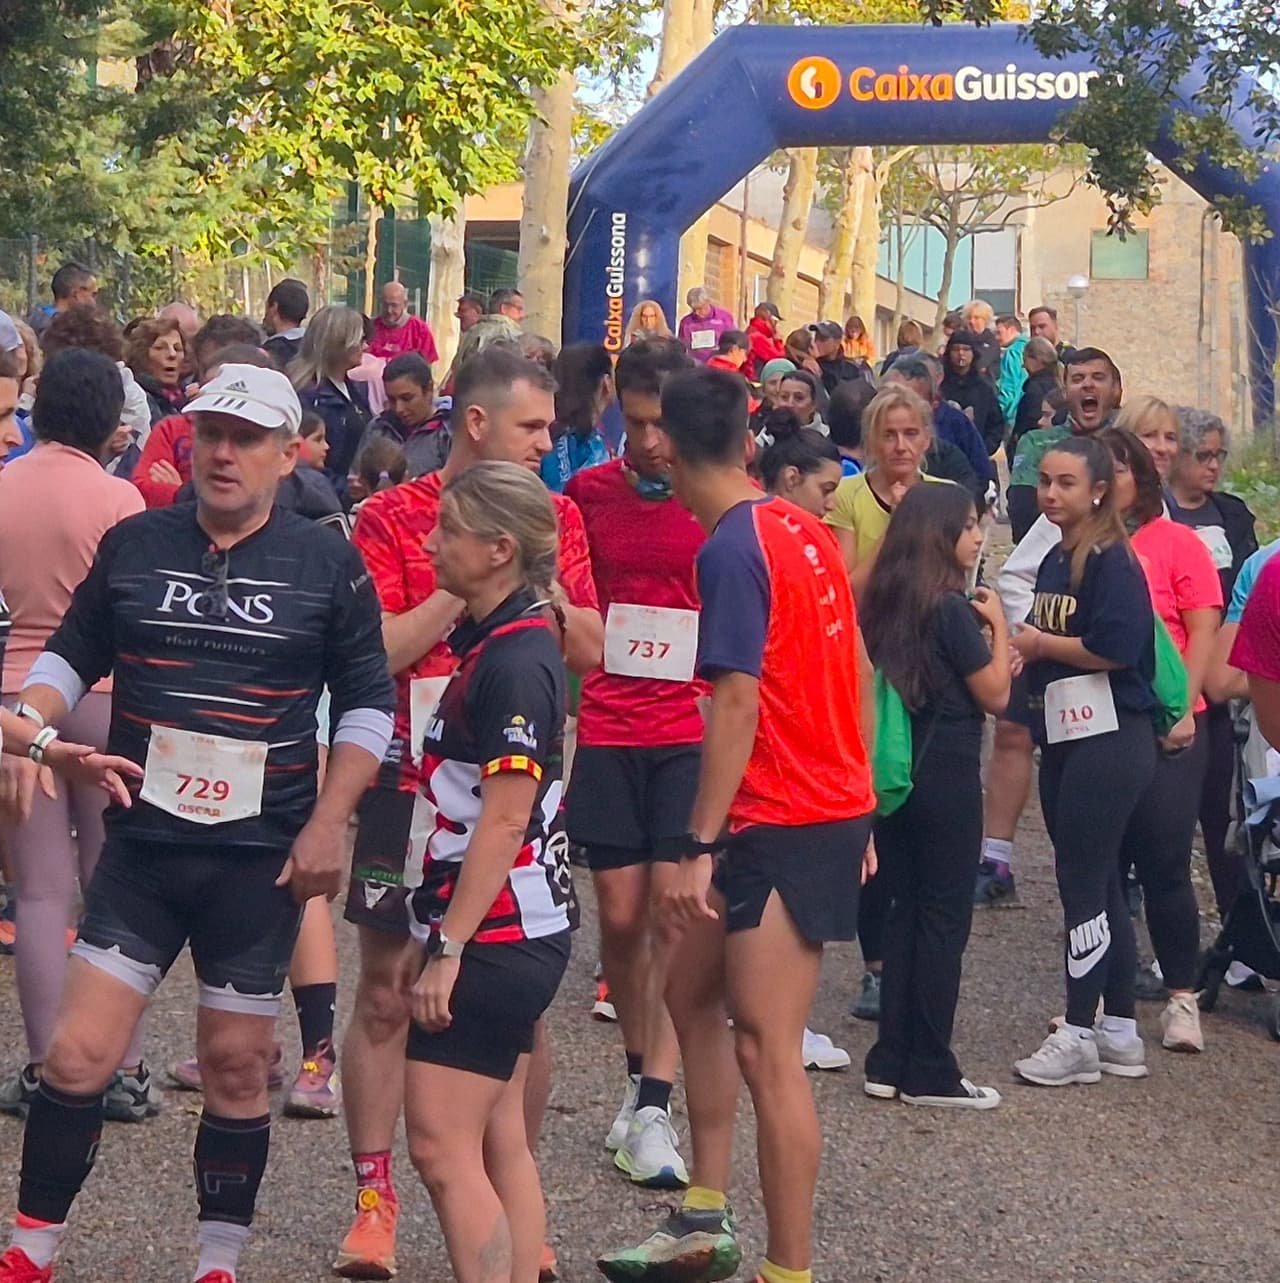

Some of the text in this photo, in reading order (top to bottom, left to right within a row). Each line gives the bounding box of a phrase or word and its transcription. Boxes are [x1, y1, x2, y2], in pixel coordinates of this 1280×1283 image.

[849, 64, 1125, 101] CaixaGuisso
[603, 212, 626, 351] CaixaGuissona
[628, 639, 671, 660] 737
[1058, 704, 1094, 724] 710
[175, 773, 231, 802] 729
[177, 803, 222, 818] OSCAR
